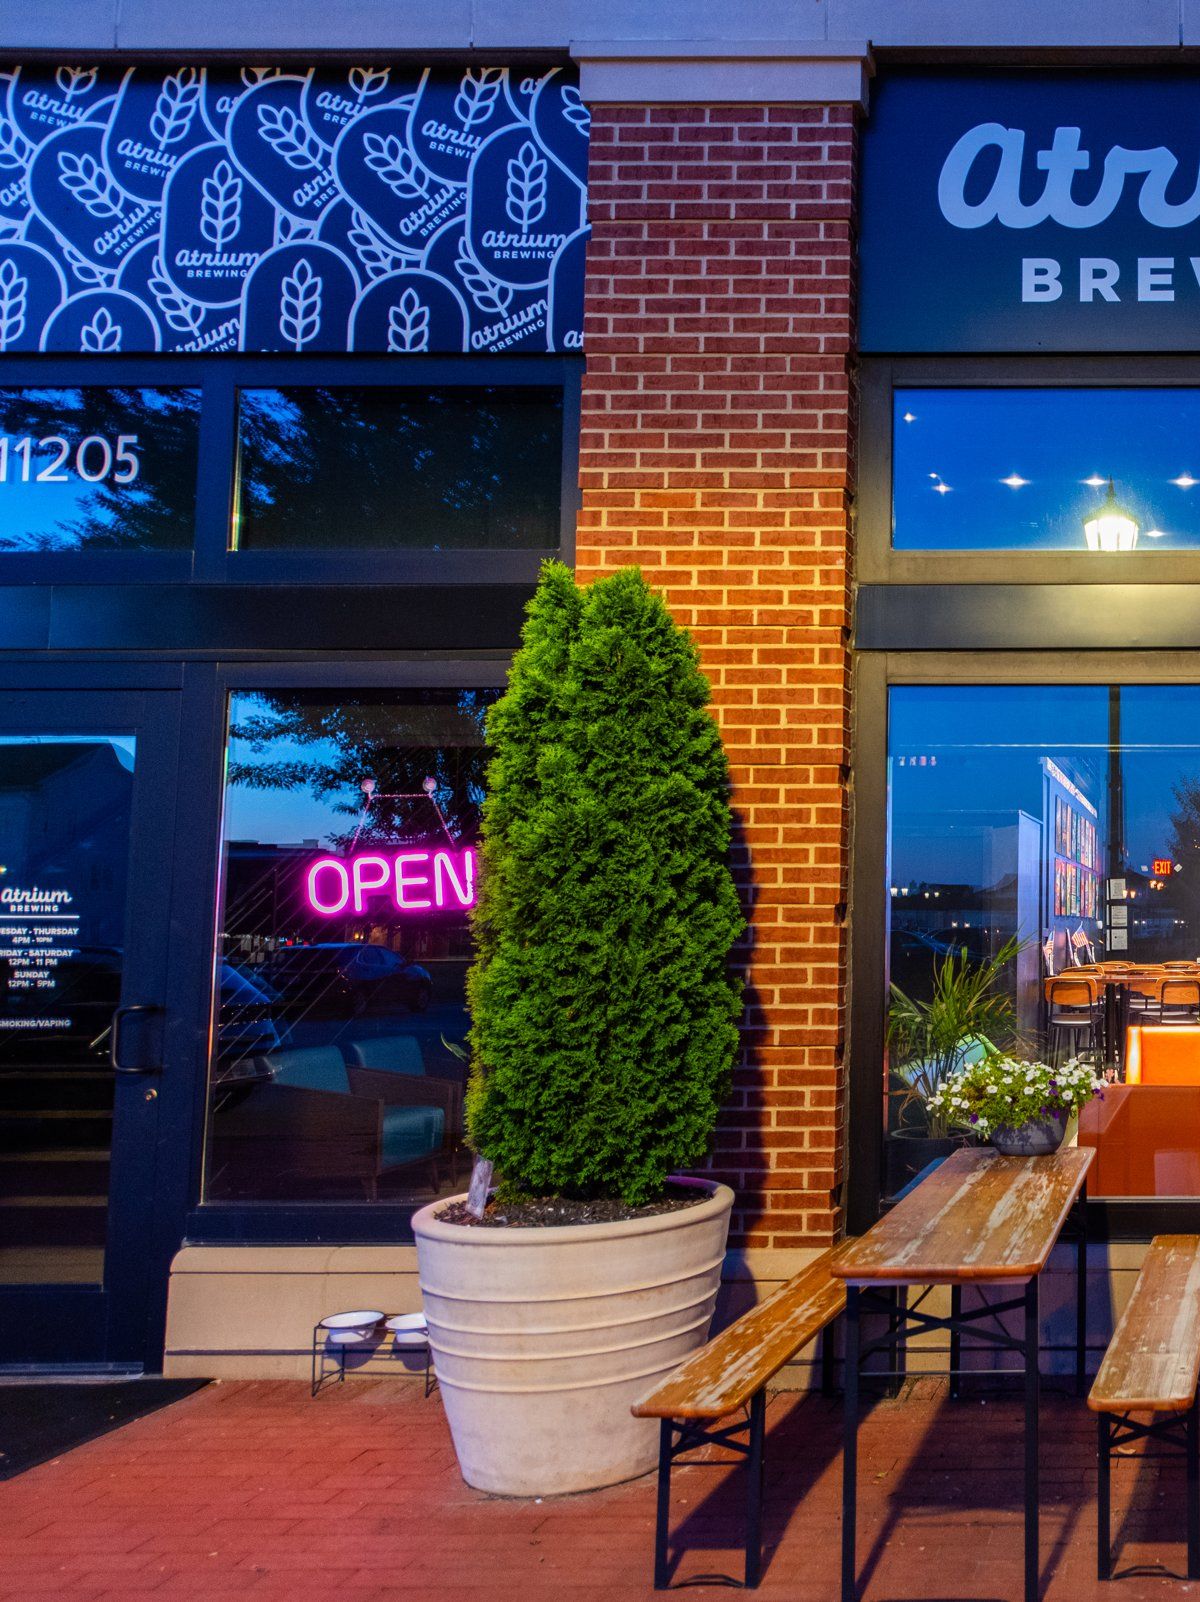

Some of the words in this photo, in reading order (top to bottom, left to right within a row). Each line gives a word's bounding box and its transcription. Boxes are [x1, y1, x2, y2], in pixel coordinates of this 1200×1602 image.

[22, 90, 84, 120] atriu
[422, 120, 482, 149] atriu
[117, 139, 179, 168] atriu
[429, 141, 477, 159] BREWI
[124, 161, 171, 177] BREWI
[420, 190, 468, 237] BREWING
[114, 211, 162, 256] BREWING
[493, 251, 555, 260] BREWING
[187, 269, 248, 278] BREWING
[0, 435, 139, 483] 11205
[1154, 861, 1171, 874] EXIT
[308, 851, 474, 914] OPEN
[0, 886, 73, 903] atrium
[0, 949, 23, 957] RIDAY
[29, 949, 73, 957] SATURDAY
[14, 971, 49, 979] SUNDAY
[0, 1020, 71, 1028] MOKING/VAPING
